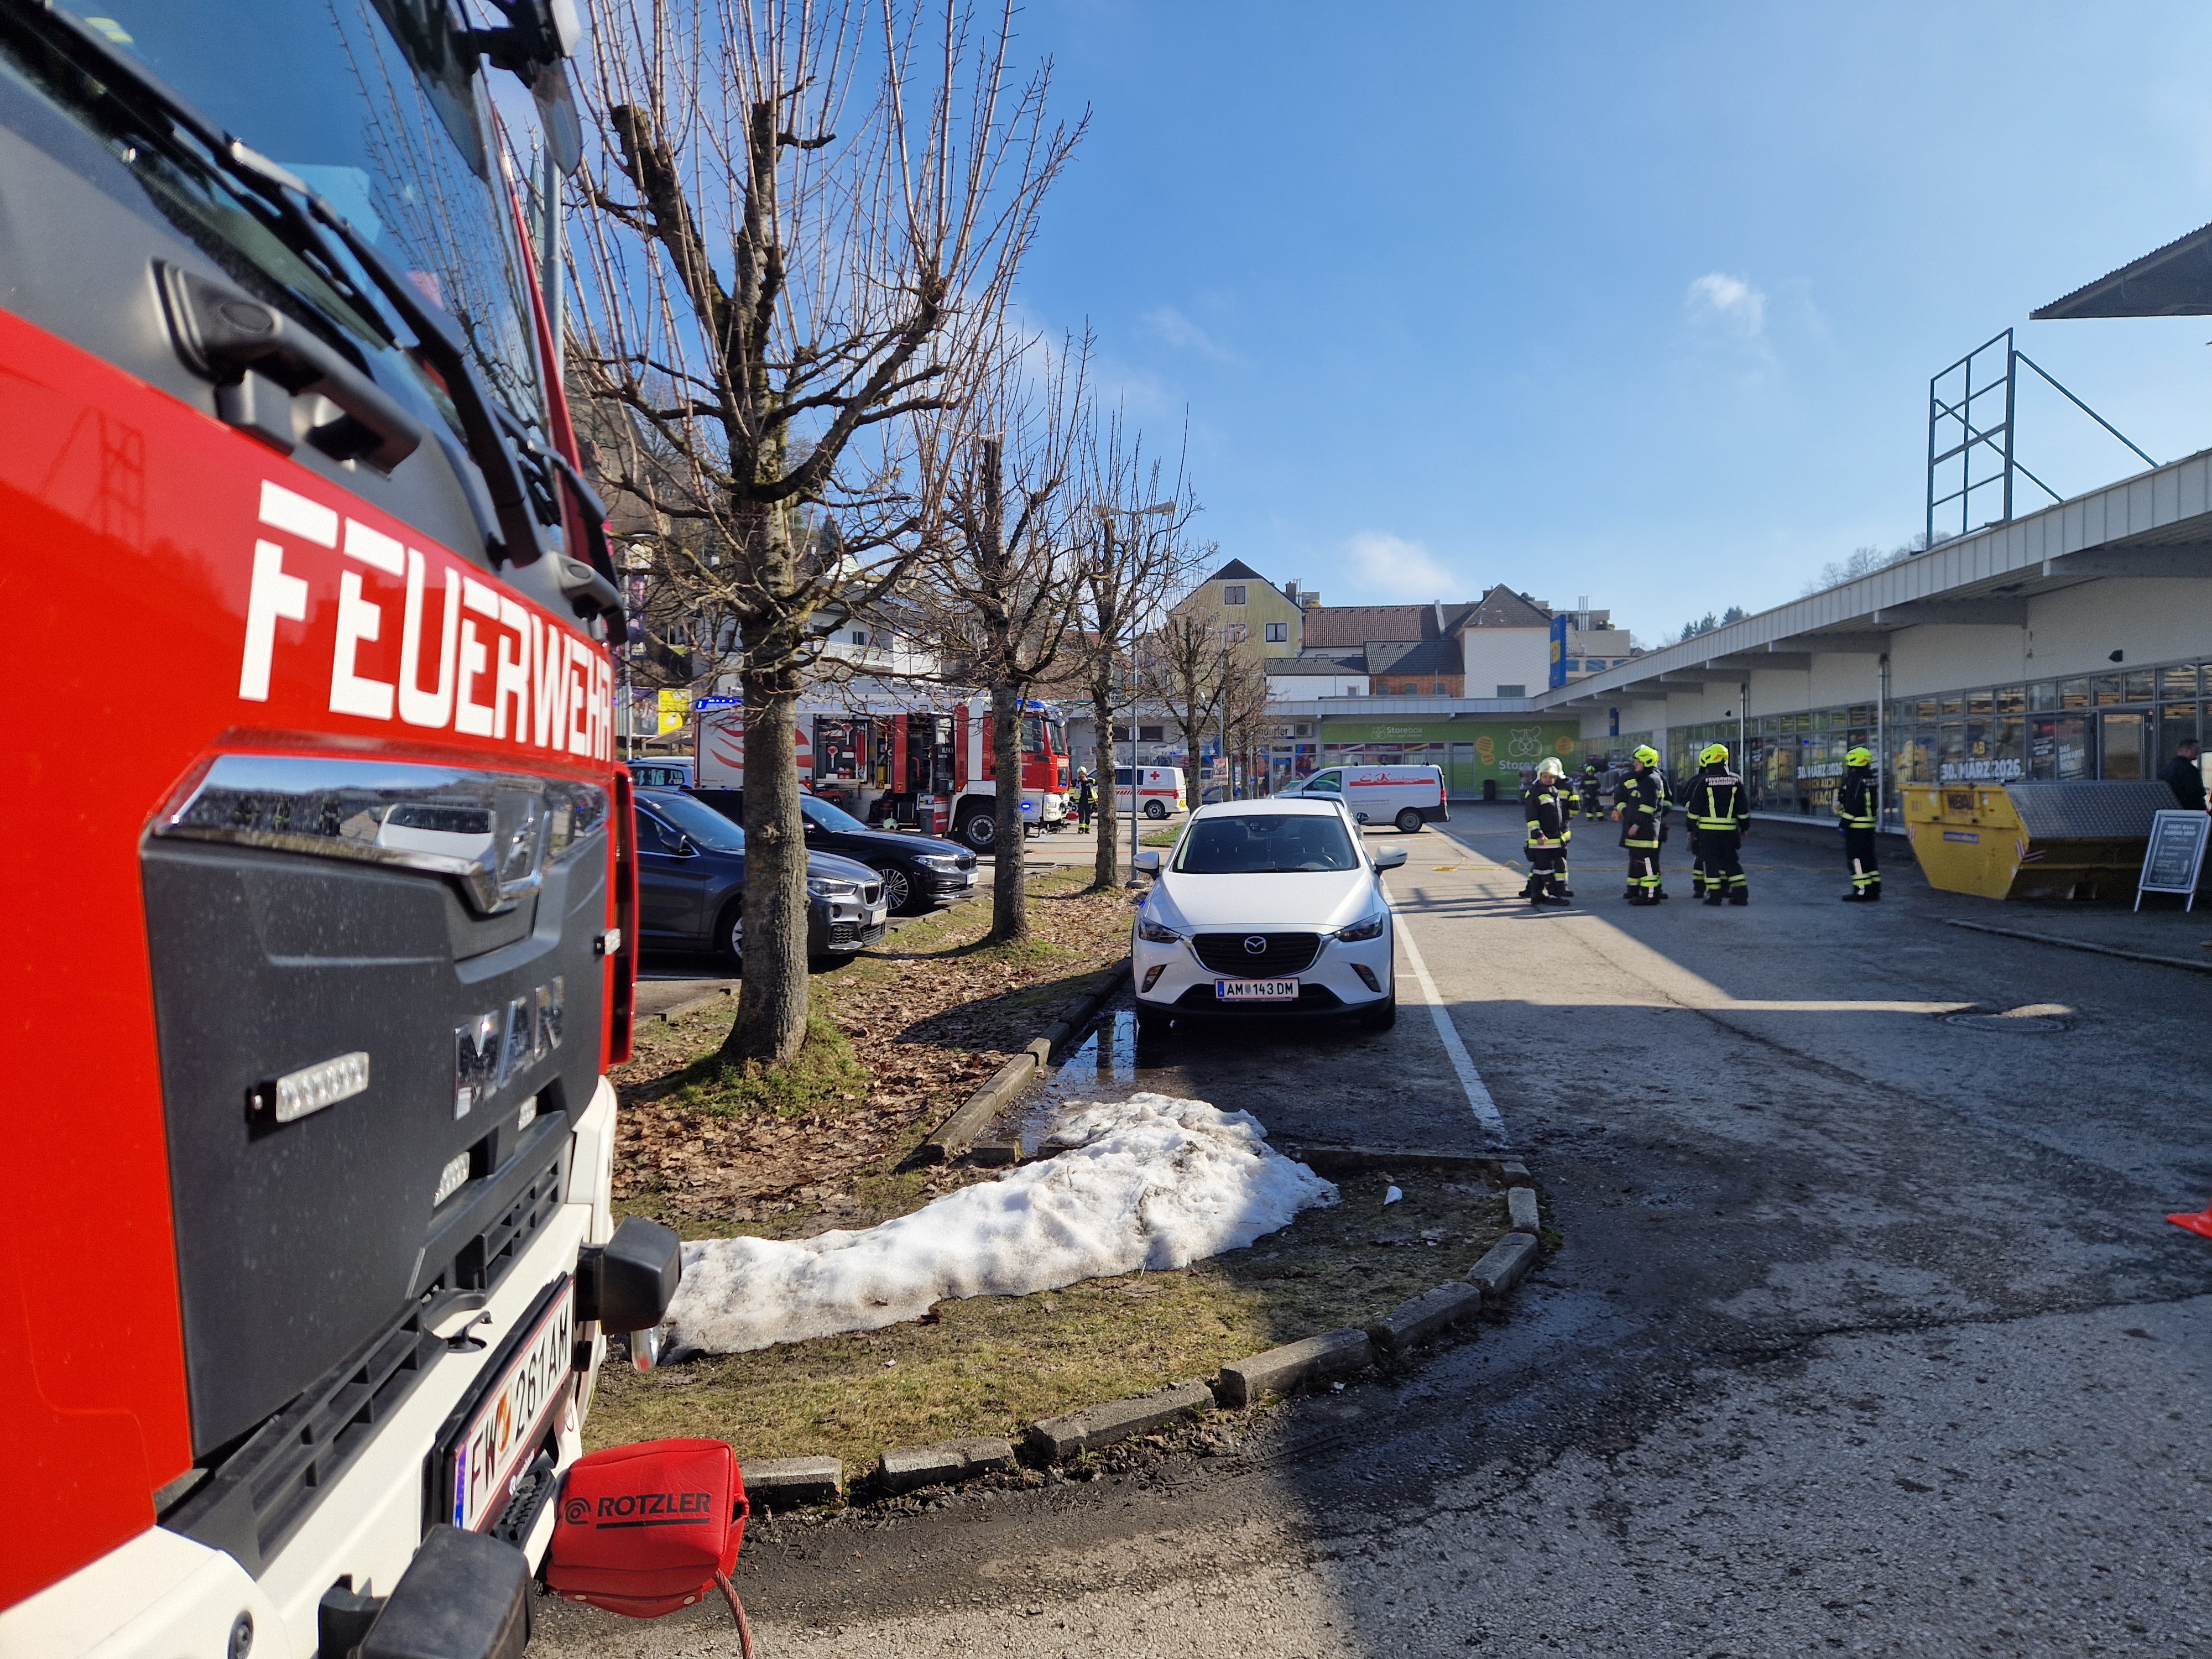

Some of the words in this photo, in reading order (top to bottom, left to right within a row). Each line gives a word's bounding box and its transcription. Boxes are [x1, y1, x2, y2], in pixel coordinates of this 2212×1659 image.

[239, 479, 612, 763] FEUERWEHR
[1797, 765, 1808, 780] 30.
[1940, 763, 1958, 780] 30.
[1958, 757, 1991, 779] MÄRZ
[1991, 758, 2021, 778] 2026
[1227, 983, 1243, 995] AM
[1253, 983, 1274, 995] 143
[1277, 982, 1293, 995] DM
[453, 975, 565, 1120] MAN
[469, 1402, 498, 1520] FW
[515, 1334, 545, 1443] 261
[547, 1302, 569, 1391] AM
[597, 1493, 712, 1518] ROTZLER
